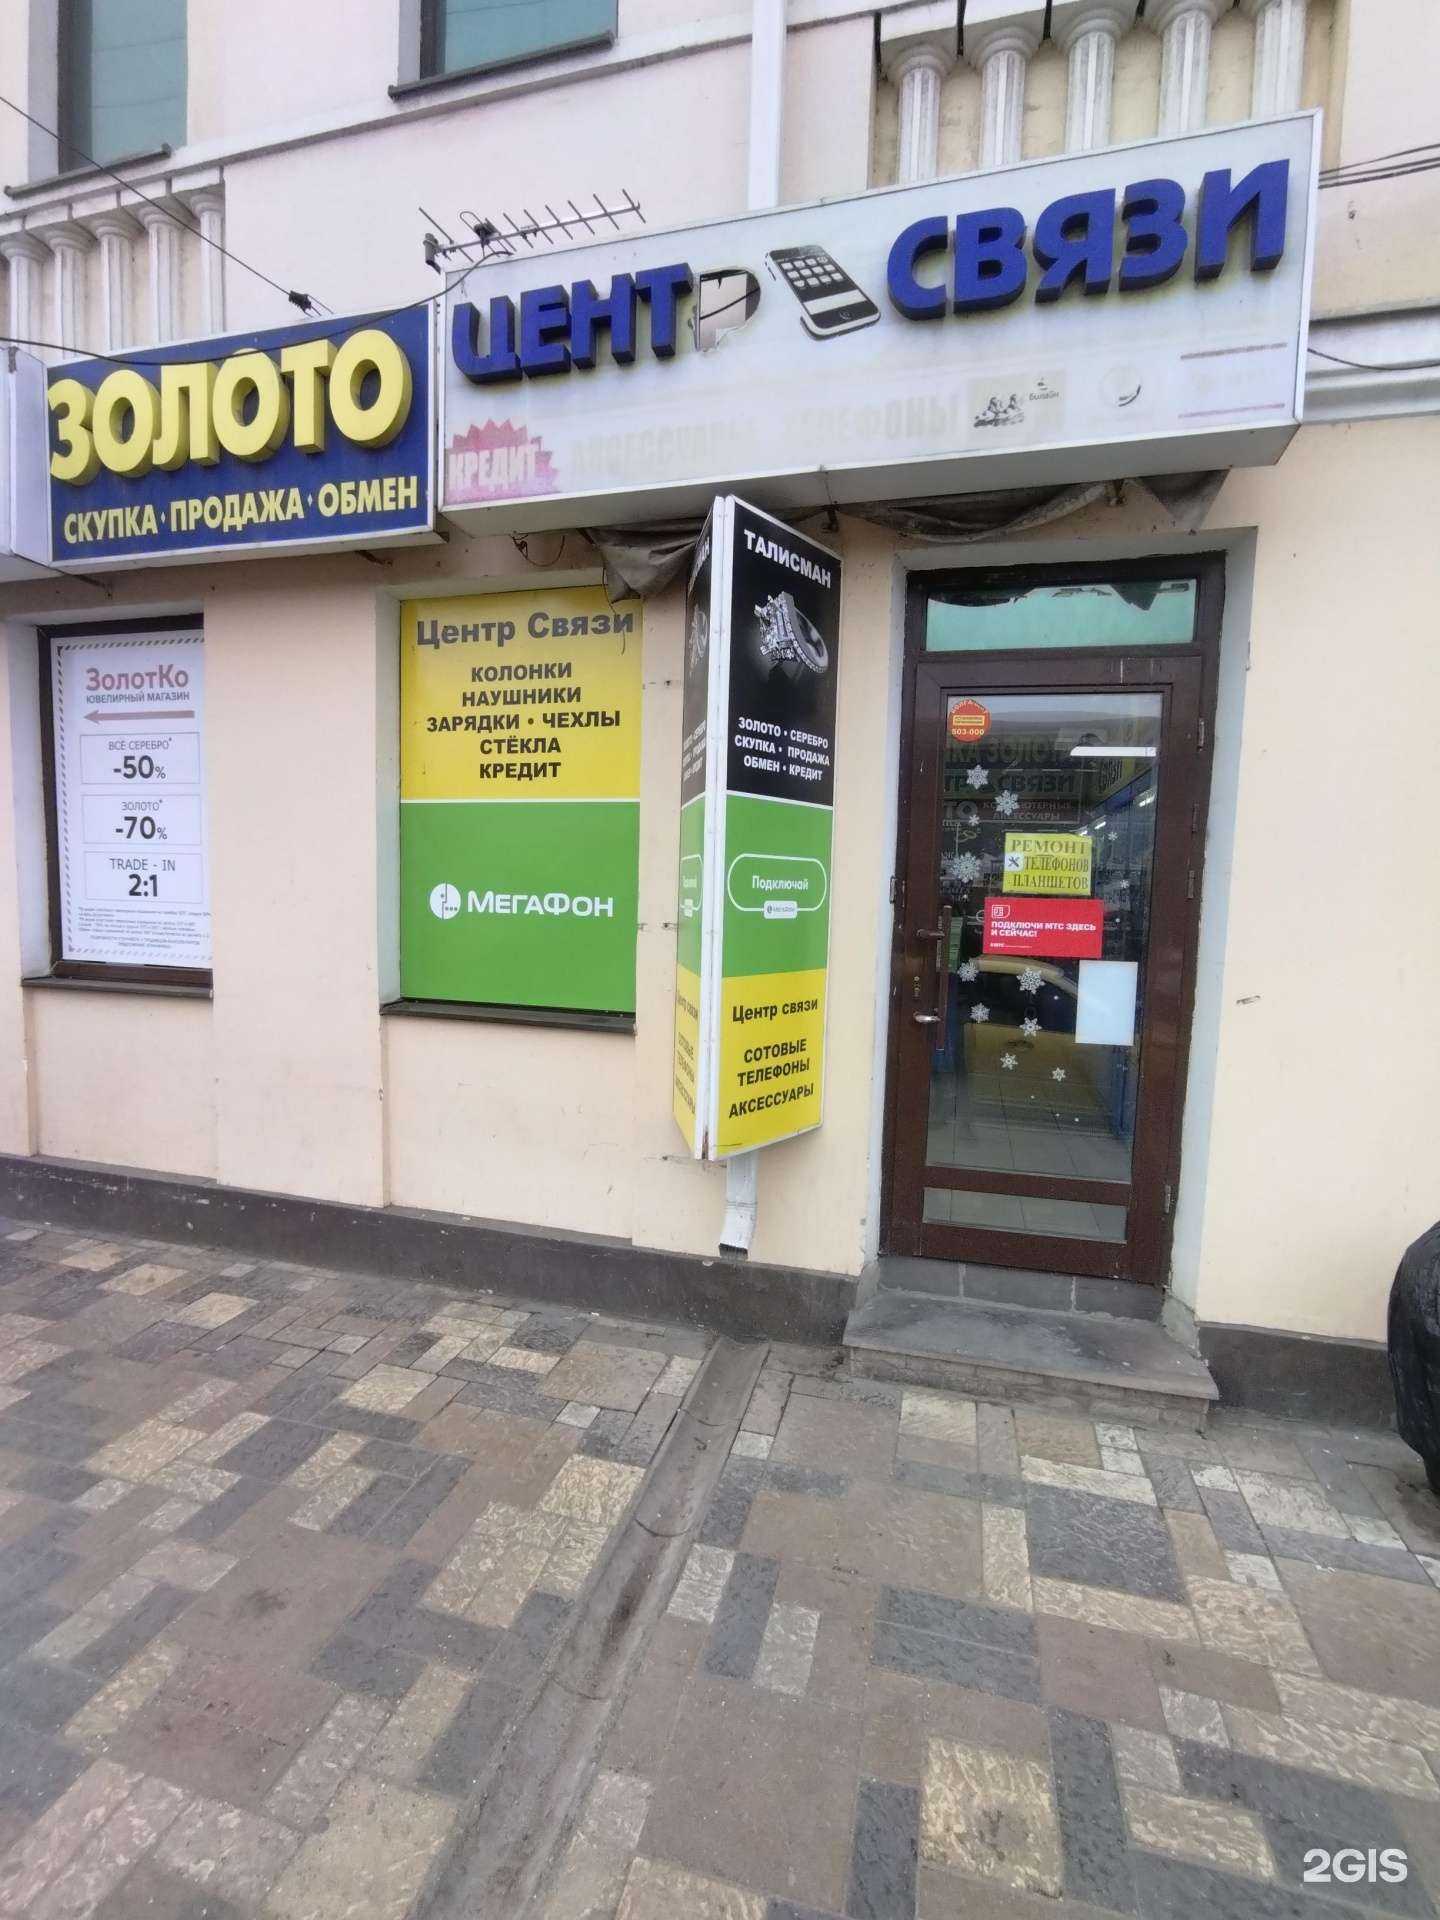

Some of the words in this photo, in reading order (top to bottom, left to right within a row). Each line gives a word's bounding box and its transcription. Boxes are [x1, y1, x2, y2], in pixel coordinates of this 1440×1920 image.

[887, 158, 1290, 320] СВЯЗИ
[47, 329, 412, 485] ЗОЛОТО
[64, 504, 158, 544] СКУПКА
[170, 488, 304, 532] ПРОДАЖА
[318, 476, 418, 516] ОБМЕН
[744, 529, 831, 589] ТАЛИСМАН
[417, 619, 515, 649] Центр
[528, 611, 634, 639] Связи
[86, 664, 189, 691] ЗолотКо
[471, 662, 572, 683] КОЛОНКИ
[86, 691, 145, 704] ЮВЕЛИРНЫЙ
[147, 692, 190, 702] МАГАЗИН
[462, 687, 582, 707] НАУШНИКИ
[426, 714, 520, 733] ЗАРЯДКИ
[543, 710, 620, 729] ЧЕХЛЫ
[738, 717, 781, 737] ЗОЛОТО
[790, 730, 829, 749] СЕРЕБРО
[480, 735, 562, 755] СТЁКЛА
[735, 735, 776, 754] СКУПКА
[788, 746, 830, 766] ПРОДАЖА
[114, 755, 166, 779] -50%
[479, 762, 562, 780] КРЕДИТ
[744, 755, 780, 773] ОБМЕН
[789, 764, 823, 781] КРЕДИТ
[116, 816, 168, 840] -70%
[1010, 839, 1089, 854] РЕМОНТ
[110, 858, 148, 871] TRADE
[162, 859, 176, 871] IN
[1024, 856, 1088, 873] ТЕЛЕФОНОВ
[128, 873, 158, 897] 2:1
[752, 876, 809, 891] Подключай
[1013, 874, 1089, 890] ПЛАНШЕТОВ
[992, 921, 1044, 930] ПОДКЛЮЧИ
[1066, 923, 1096, 931] ЗДЕСЬ
[999, 929, 1037, 937] СЕЙЧАС!
[732, 1005, 778, 1024] Центр
[782, 1000, 818, 1015] связи
[744, 1039, 807, 1063] СОТОВЫЕ
[737, 1058, 810, 1087] ТЕЛЕФОНЫ
[729, 1083, 814, 1118] АКСЕССУАРЫ
